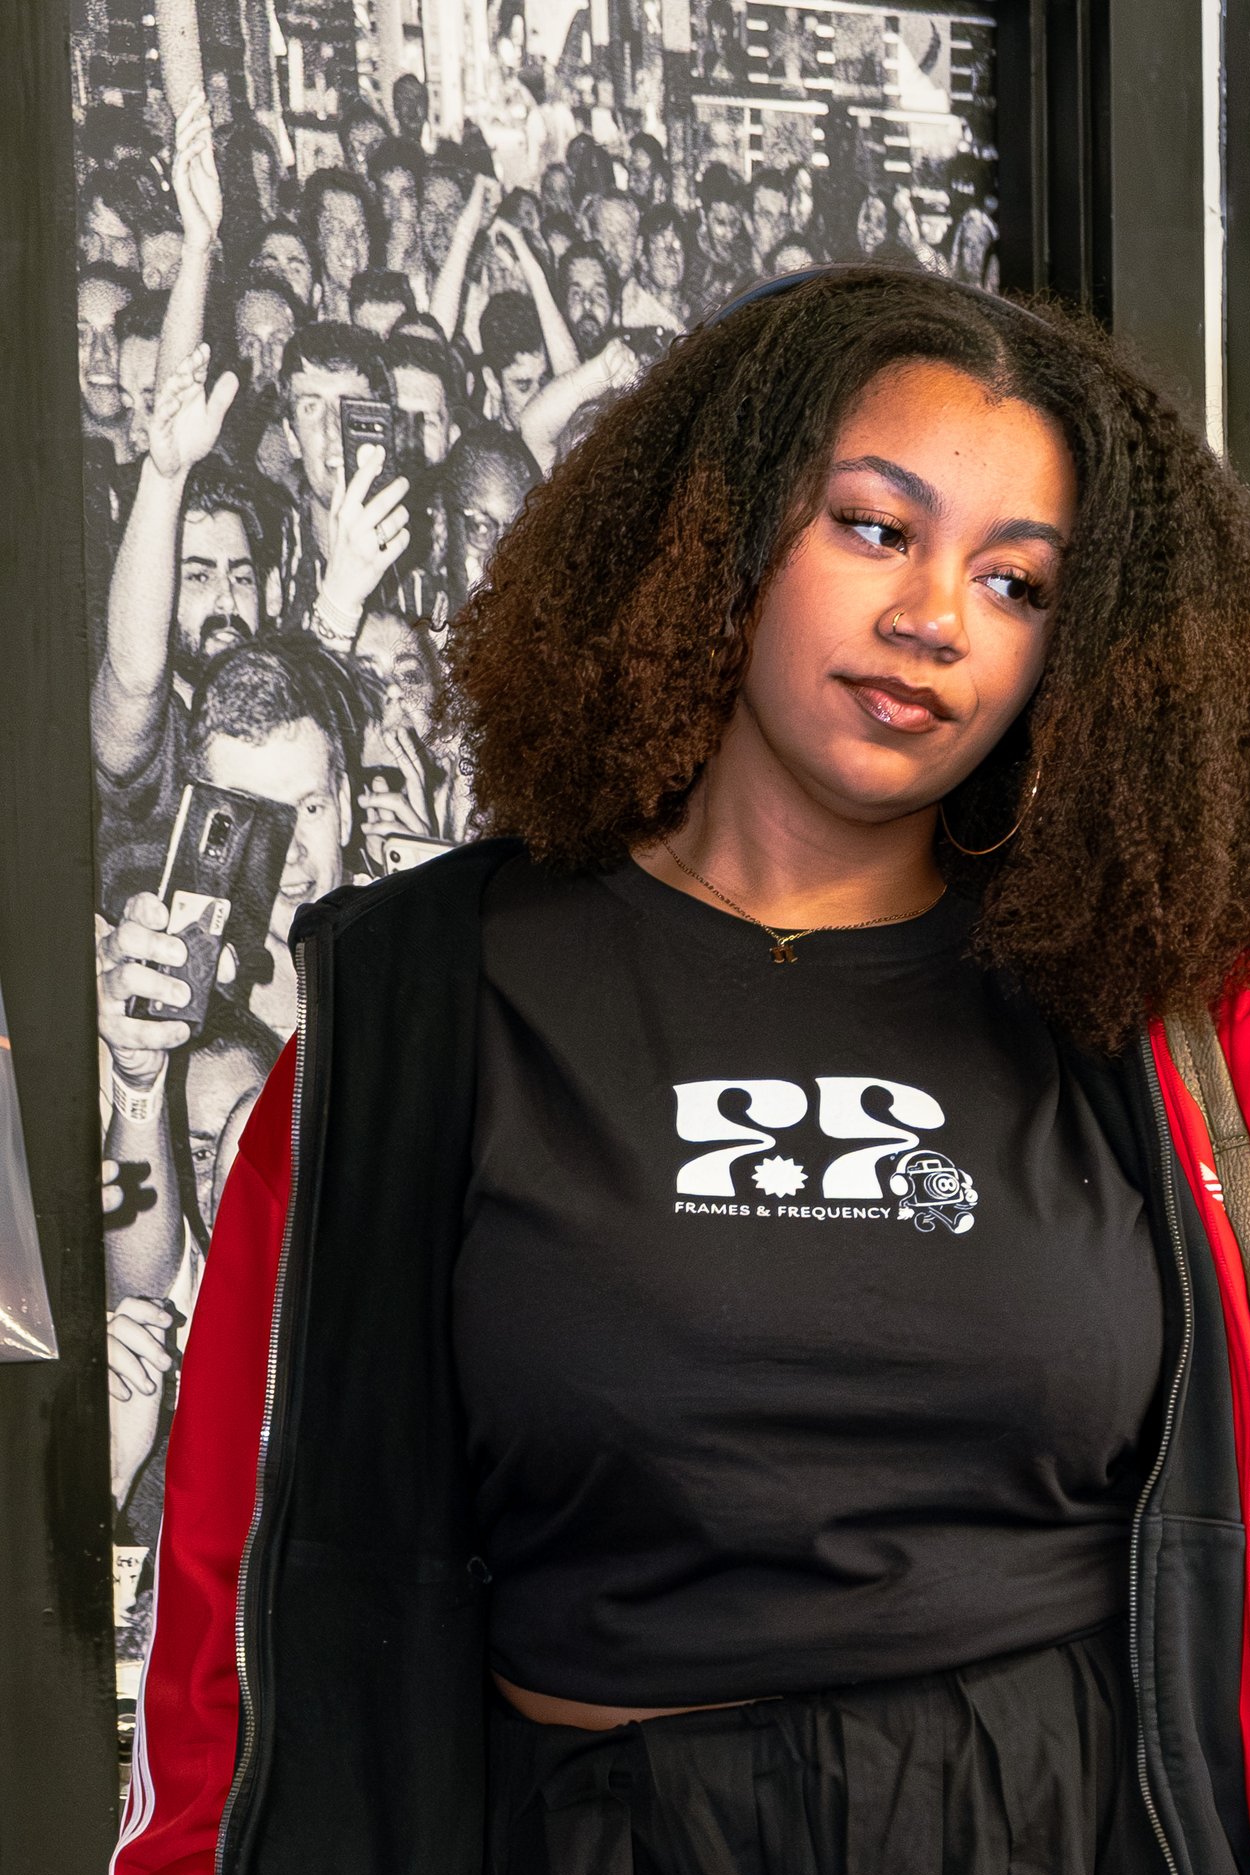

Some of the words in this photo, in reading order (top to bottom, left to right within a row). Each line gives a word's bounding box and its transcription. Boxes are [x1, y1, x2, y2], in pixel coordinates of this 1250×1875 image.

[674, 1200, 751, 1217] FRAMES
[756, 1202, 772, 1217] &
[777, 1204, 893, 1220] FREQUENCY
